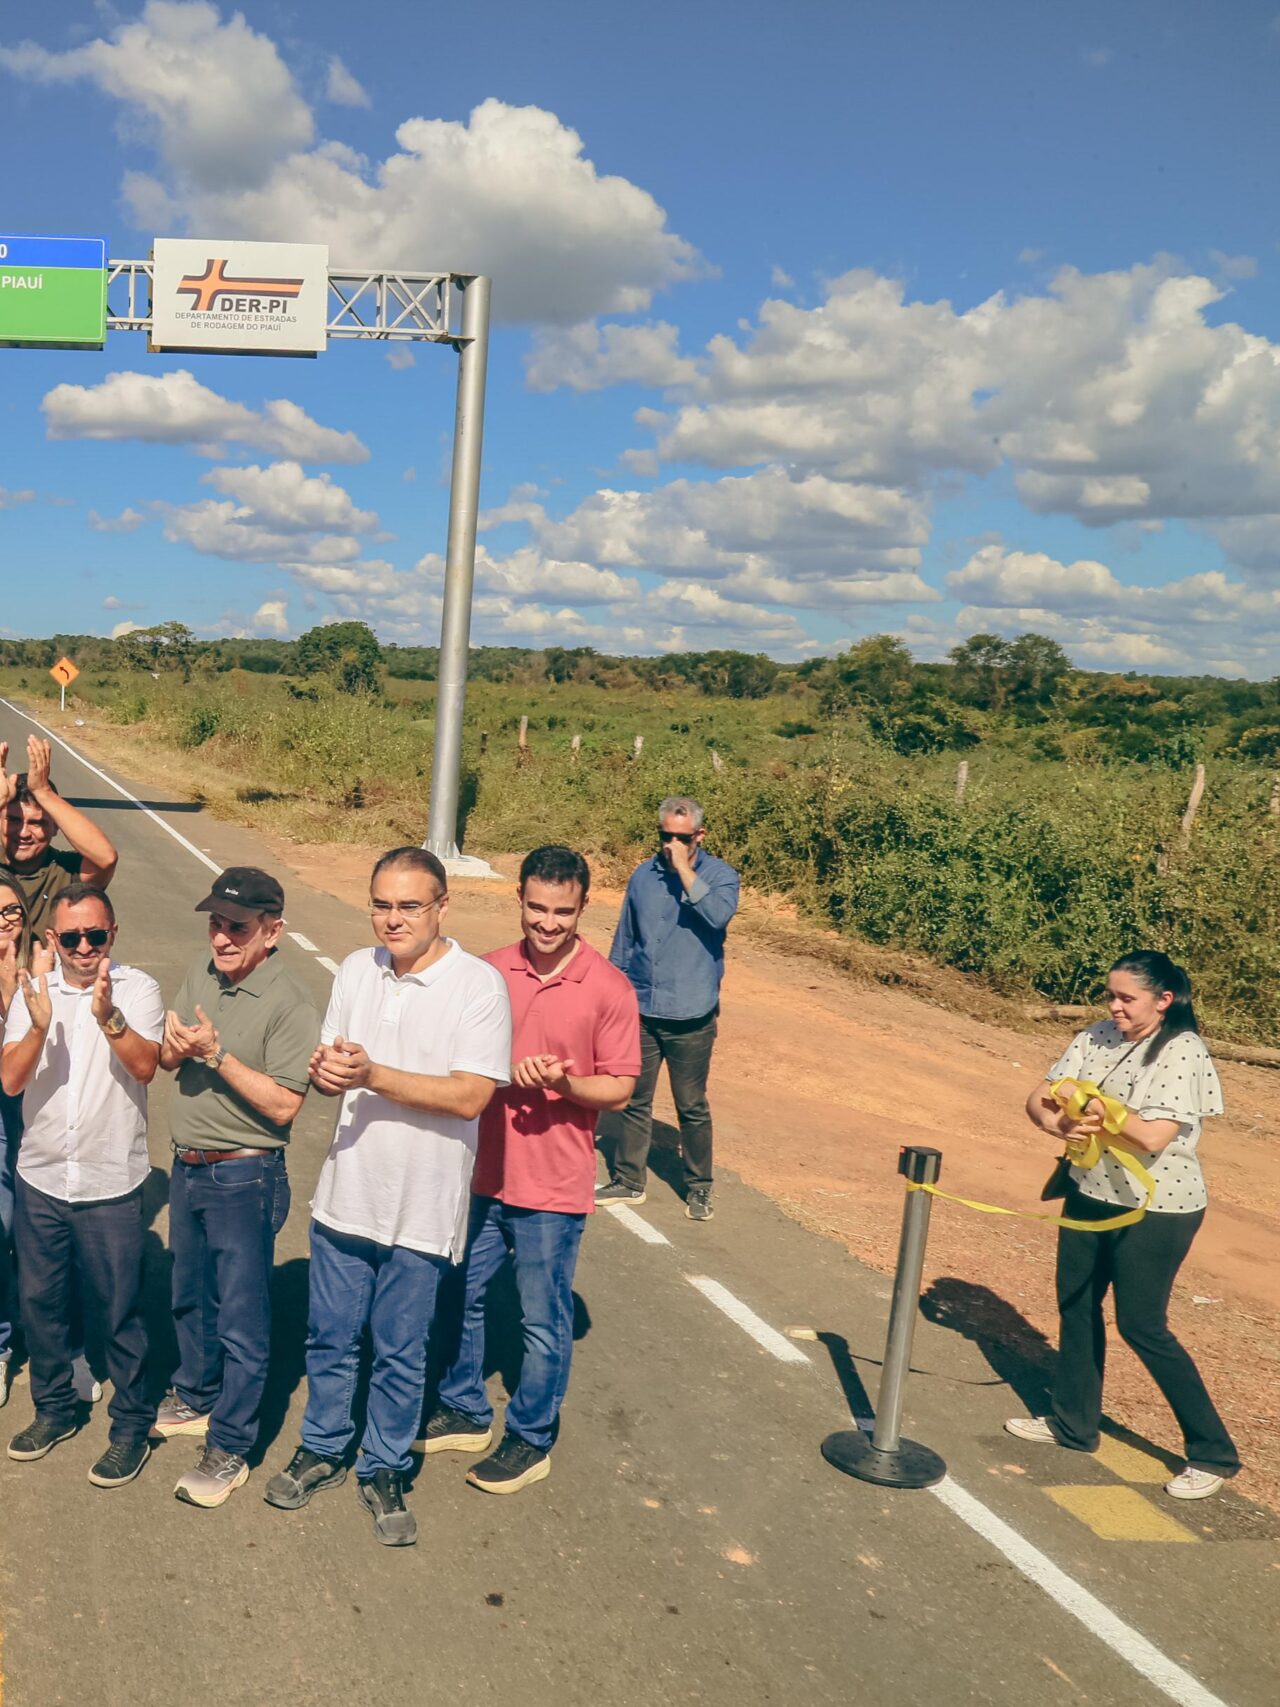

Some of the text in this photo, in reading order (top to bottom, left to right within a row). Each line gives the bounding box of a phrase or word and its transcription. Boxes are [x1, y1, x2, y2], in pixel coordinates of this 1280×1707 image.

[2, 274, 43, 290] PIAUÍ
[220, 298, 288, 314] DER-PI
[175, 312, 297, 323] DEPARTAMENTO DE ESTRADAS
[191, 321, 282, 331] DE RODAGEM DO PIAUÍ
